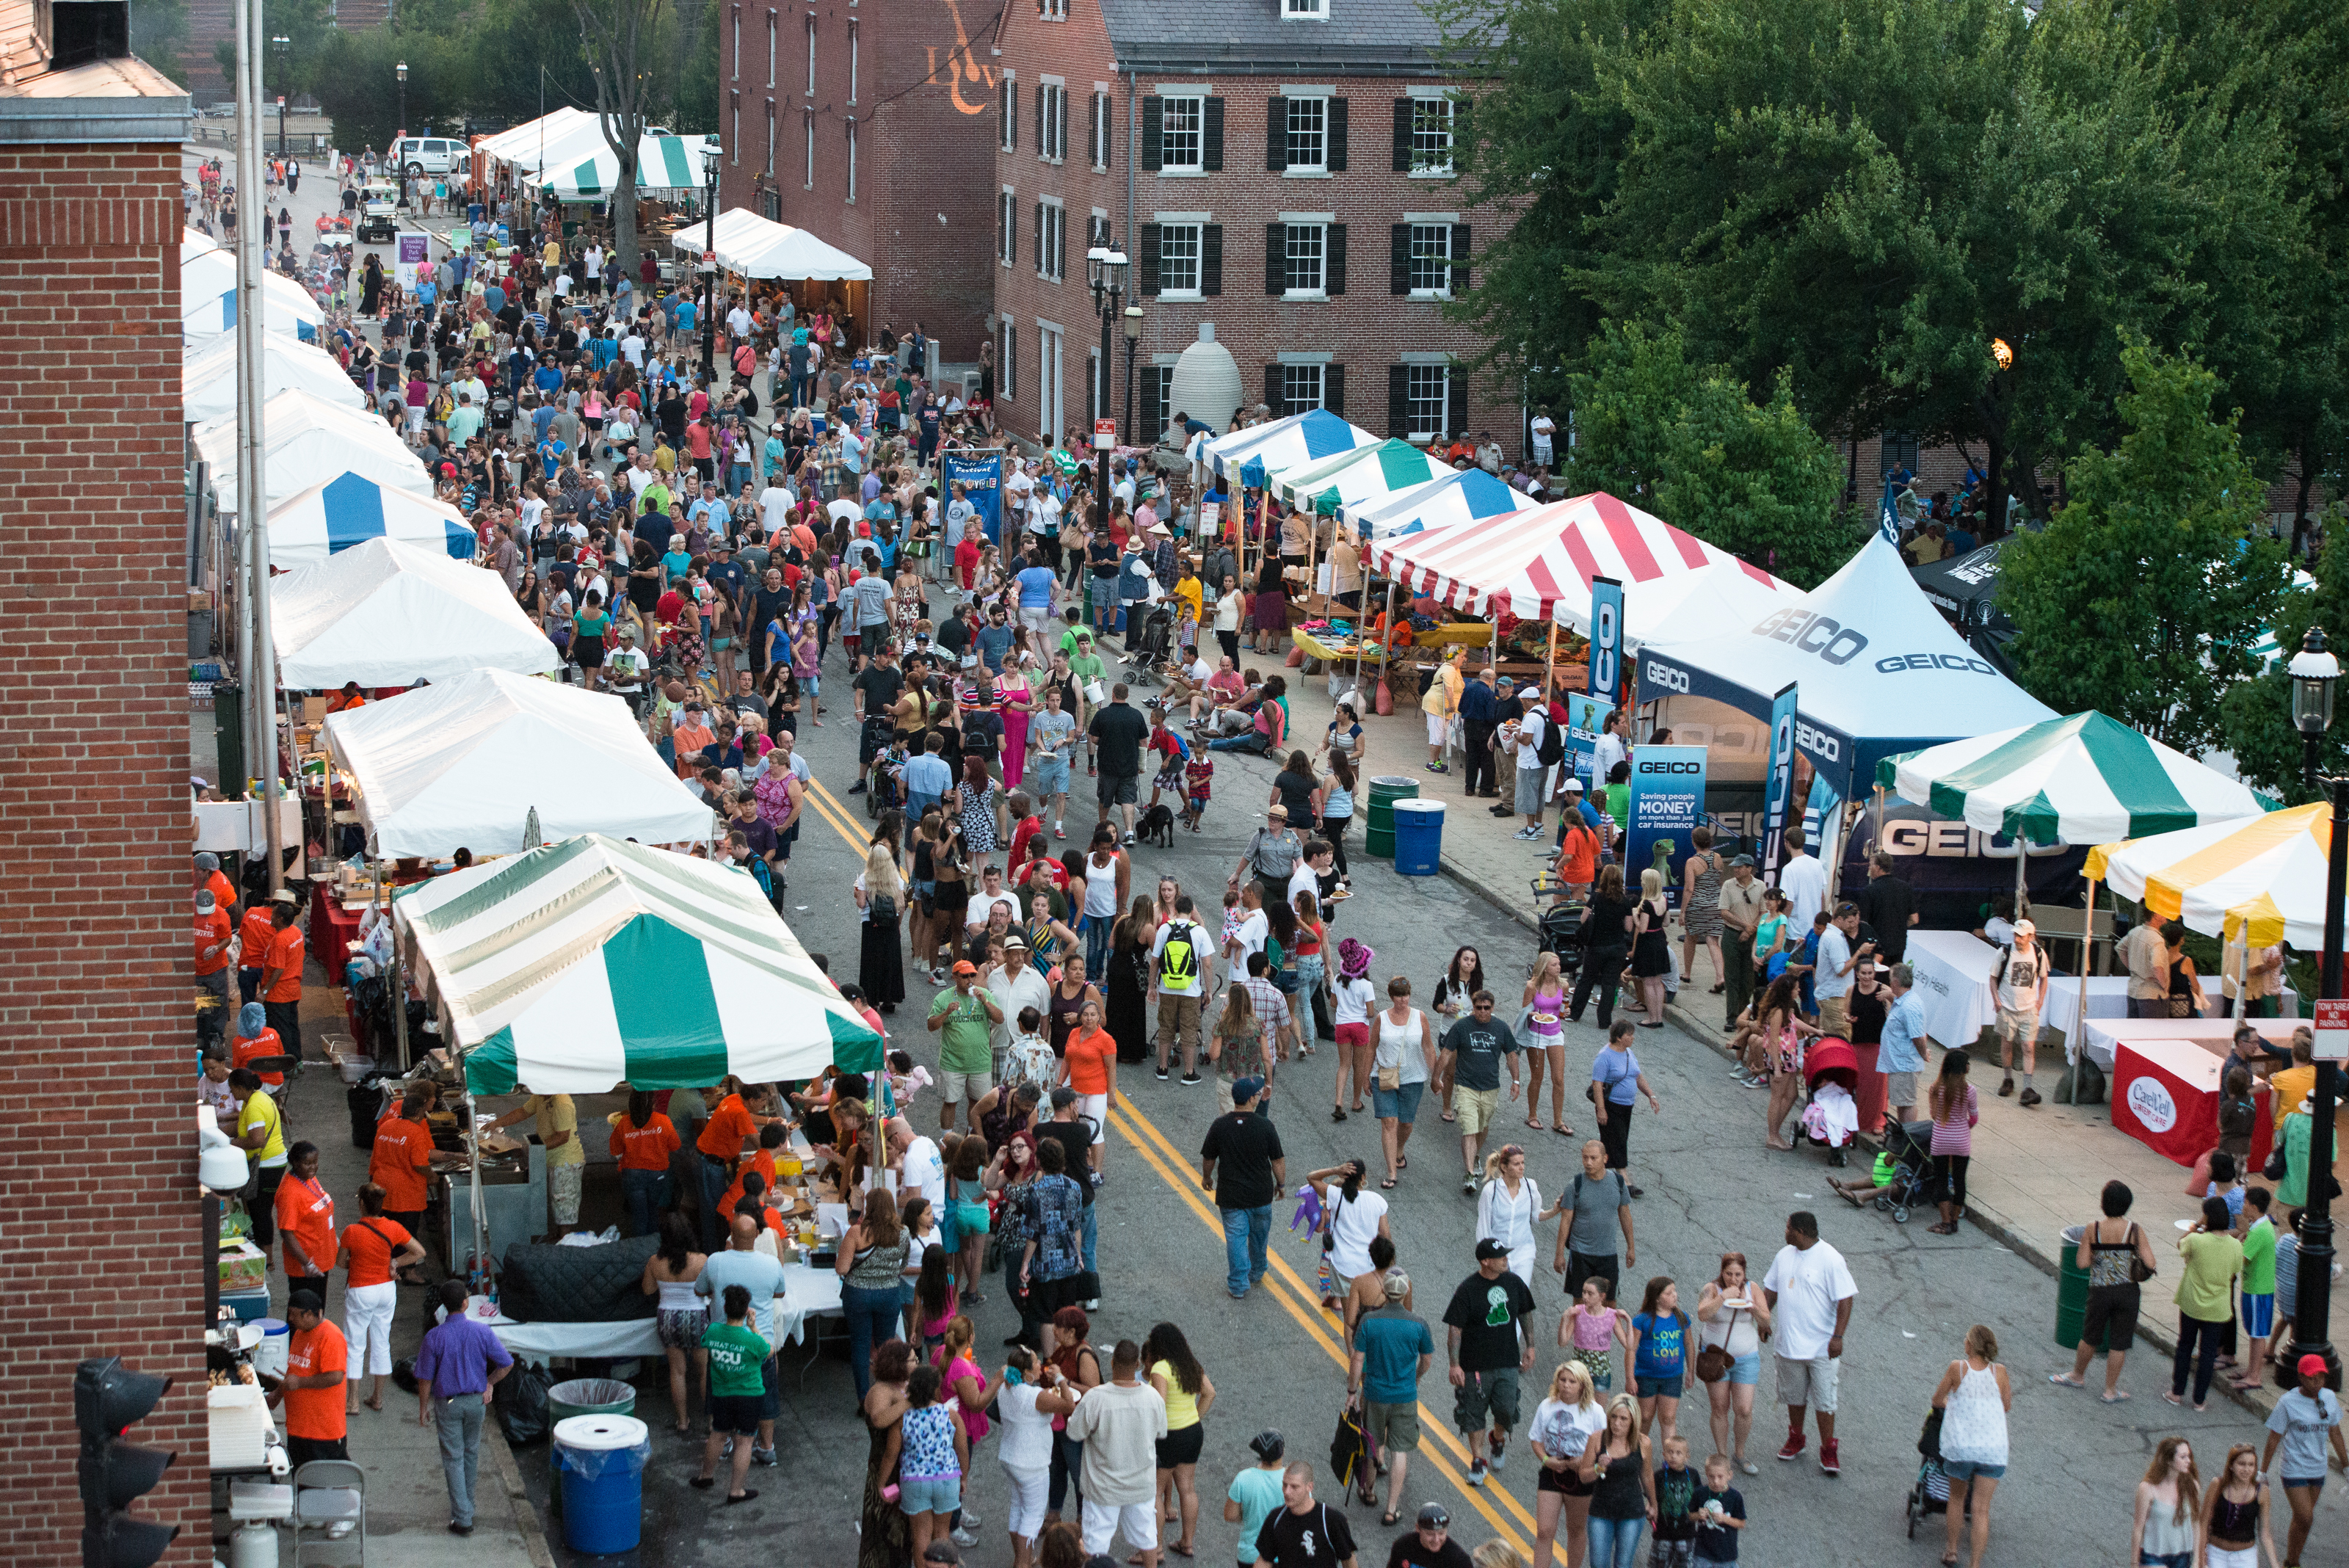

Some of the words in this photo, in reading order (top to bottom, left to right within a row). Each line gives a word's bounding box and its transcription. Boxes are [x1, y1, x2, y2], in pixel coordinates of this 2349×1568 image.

[403, 238, 425, 246] Boarding
[948, 458, 976, 467] Lowell
[979, 457, 998, 465] Folk
[1202, 504, 1208, 512] NO
[1751, 608, 1869, 666] GEICO
[1874, 653, 1997, 676] GEICO
[1647, 660, 1690, 694] GEICO
[1638, 761, 1701, 774] GEICO
[1640, 793, 1666, 801] Saving
[1668, 793, 1696, 801] people
[1638, 802, 1696, 814] MONEY
[1653, 821, 1694, 829] insurance
[2317, 1002, 2331, 1011] TOW
[949, 1014, 984, 1023] VOLUNTEER
[2328, 1011, 2339, 1019] NO
[2318, 1019, 2348, 1028] PARKING
[2151, 1113, 2167, 1128] CARE
[625, 1130, 640, 1139] sage
[639, 1127, 656, 1136] bank
[709, 1340, 730, 1350] WHAT
[730, 1343, 746, 1353] CAN
[711, 1349, 741, 1366] DCU
